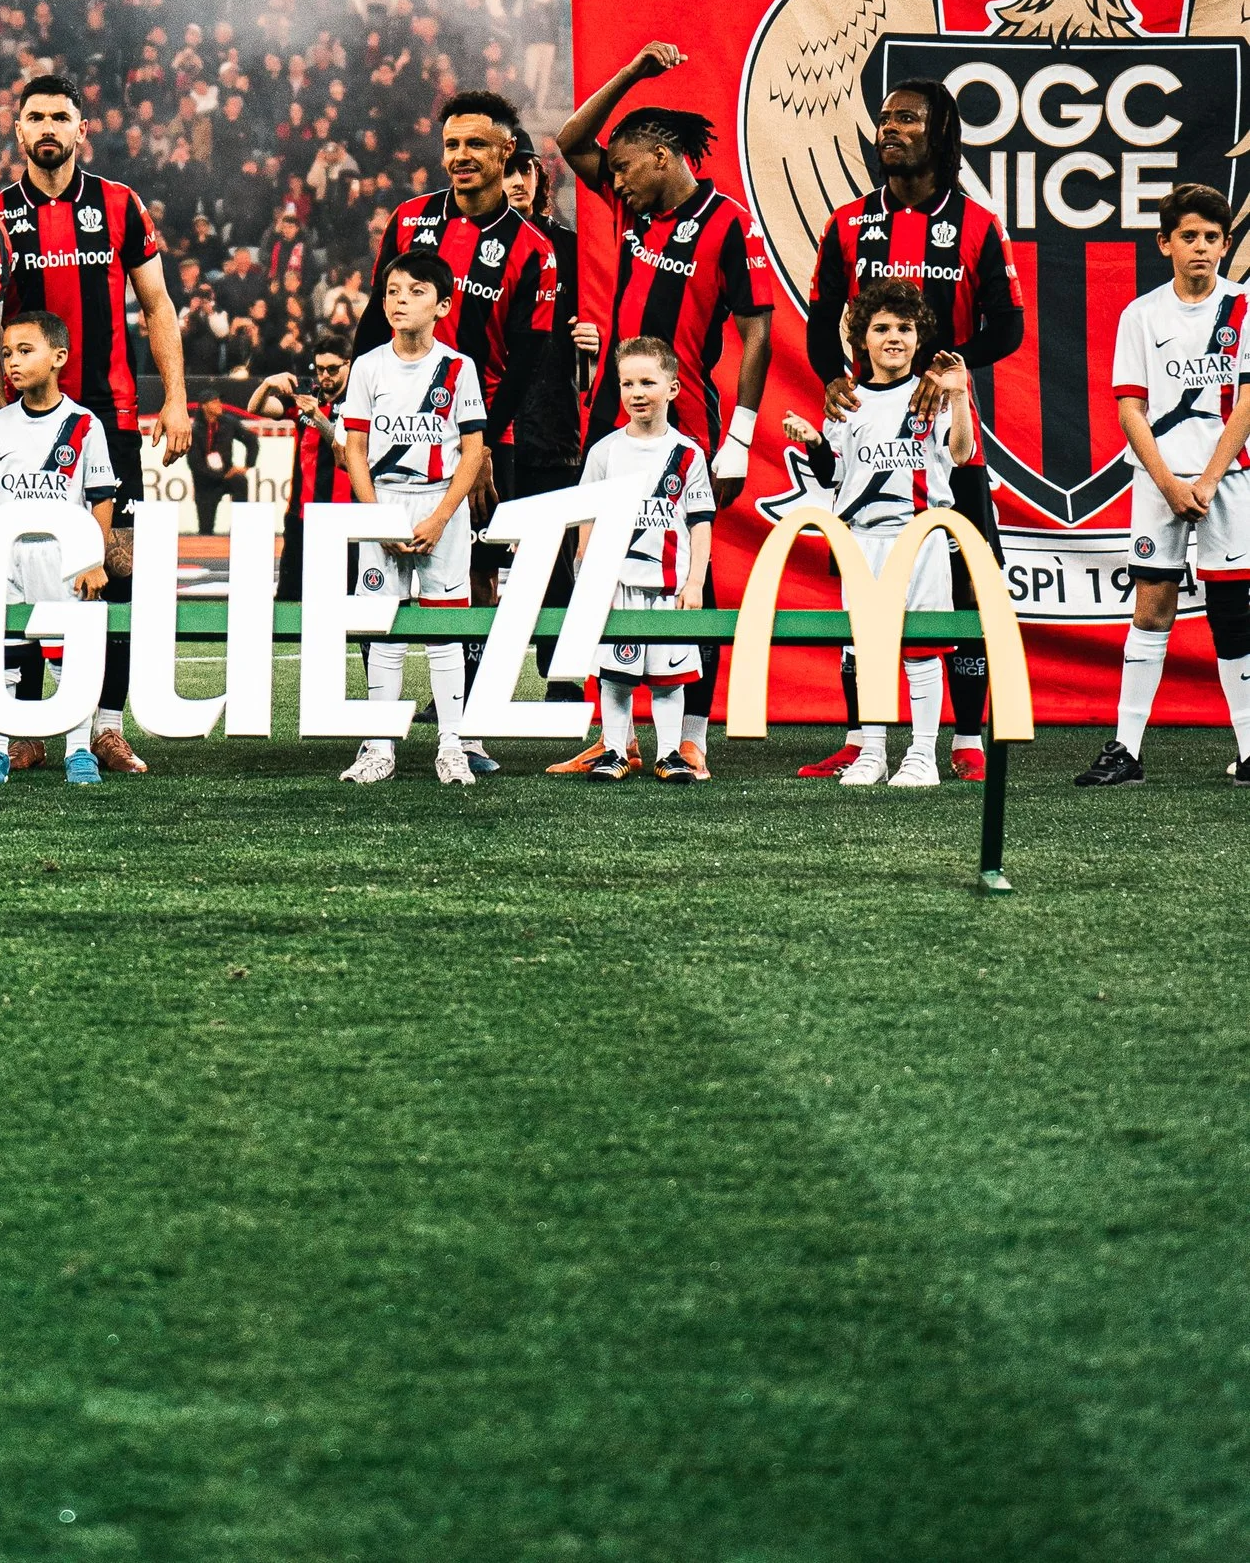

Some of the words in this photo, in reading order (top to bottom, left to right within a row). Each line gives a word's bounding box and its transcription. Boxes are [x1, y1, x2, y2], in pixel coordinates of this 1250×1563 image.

[956, 63, 1183, 147] OGC
[959, 151, 1179, 229] NICE
[402, 215, 441, 227] actual
[848, 211, 887, 226] actual
[24, 247, 114, 269] Robinhood
[871, 261, 964, 282] Robinhood
[1166, 356, 1232, 378] QATAR
[1183, 374, 1233, 386] AIRWAYS
[374, 415, 442, 434] QATAR
[391, 433, 443, 444] AIRWAYS
[858, 441, 923, 463] QATAR
[873, 459, 925, 471] AIRWAYS
[1, 473, 67, 493] QATAR
[14, 491, 68, 501] AIRWAYS
[638, 500, 675, 519] TAR
[1085, 562, 1198, 603] 194
[953, 656, 986, 667] OGC
[954, 665, 985, 676] NICE
